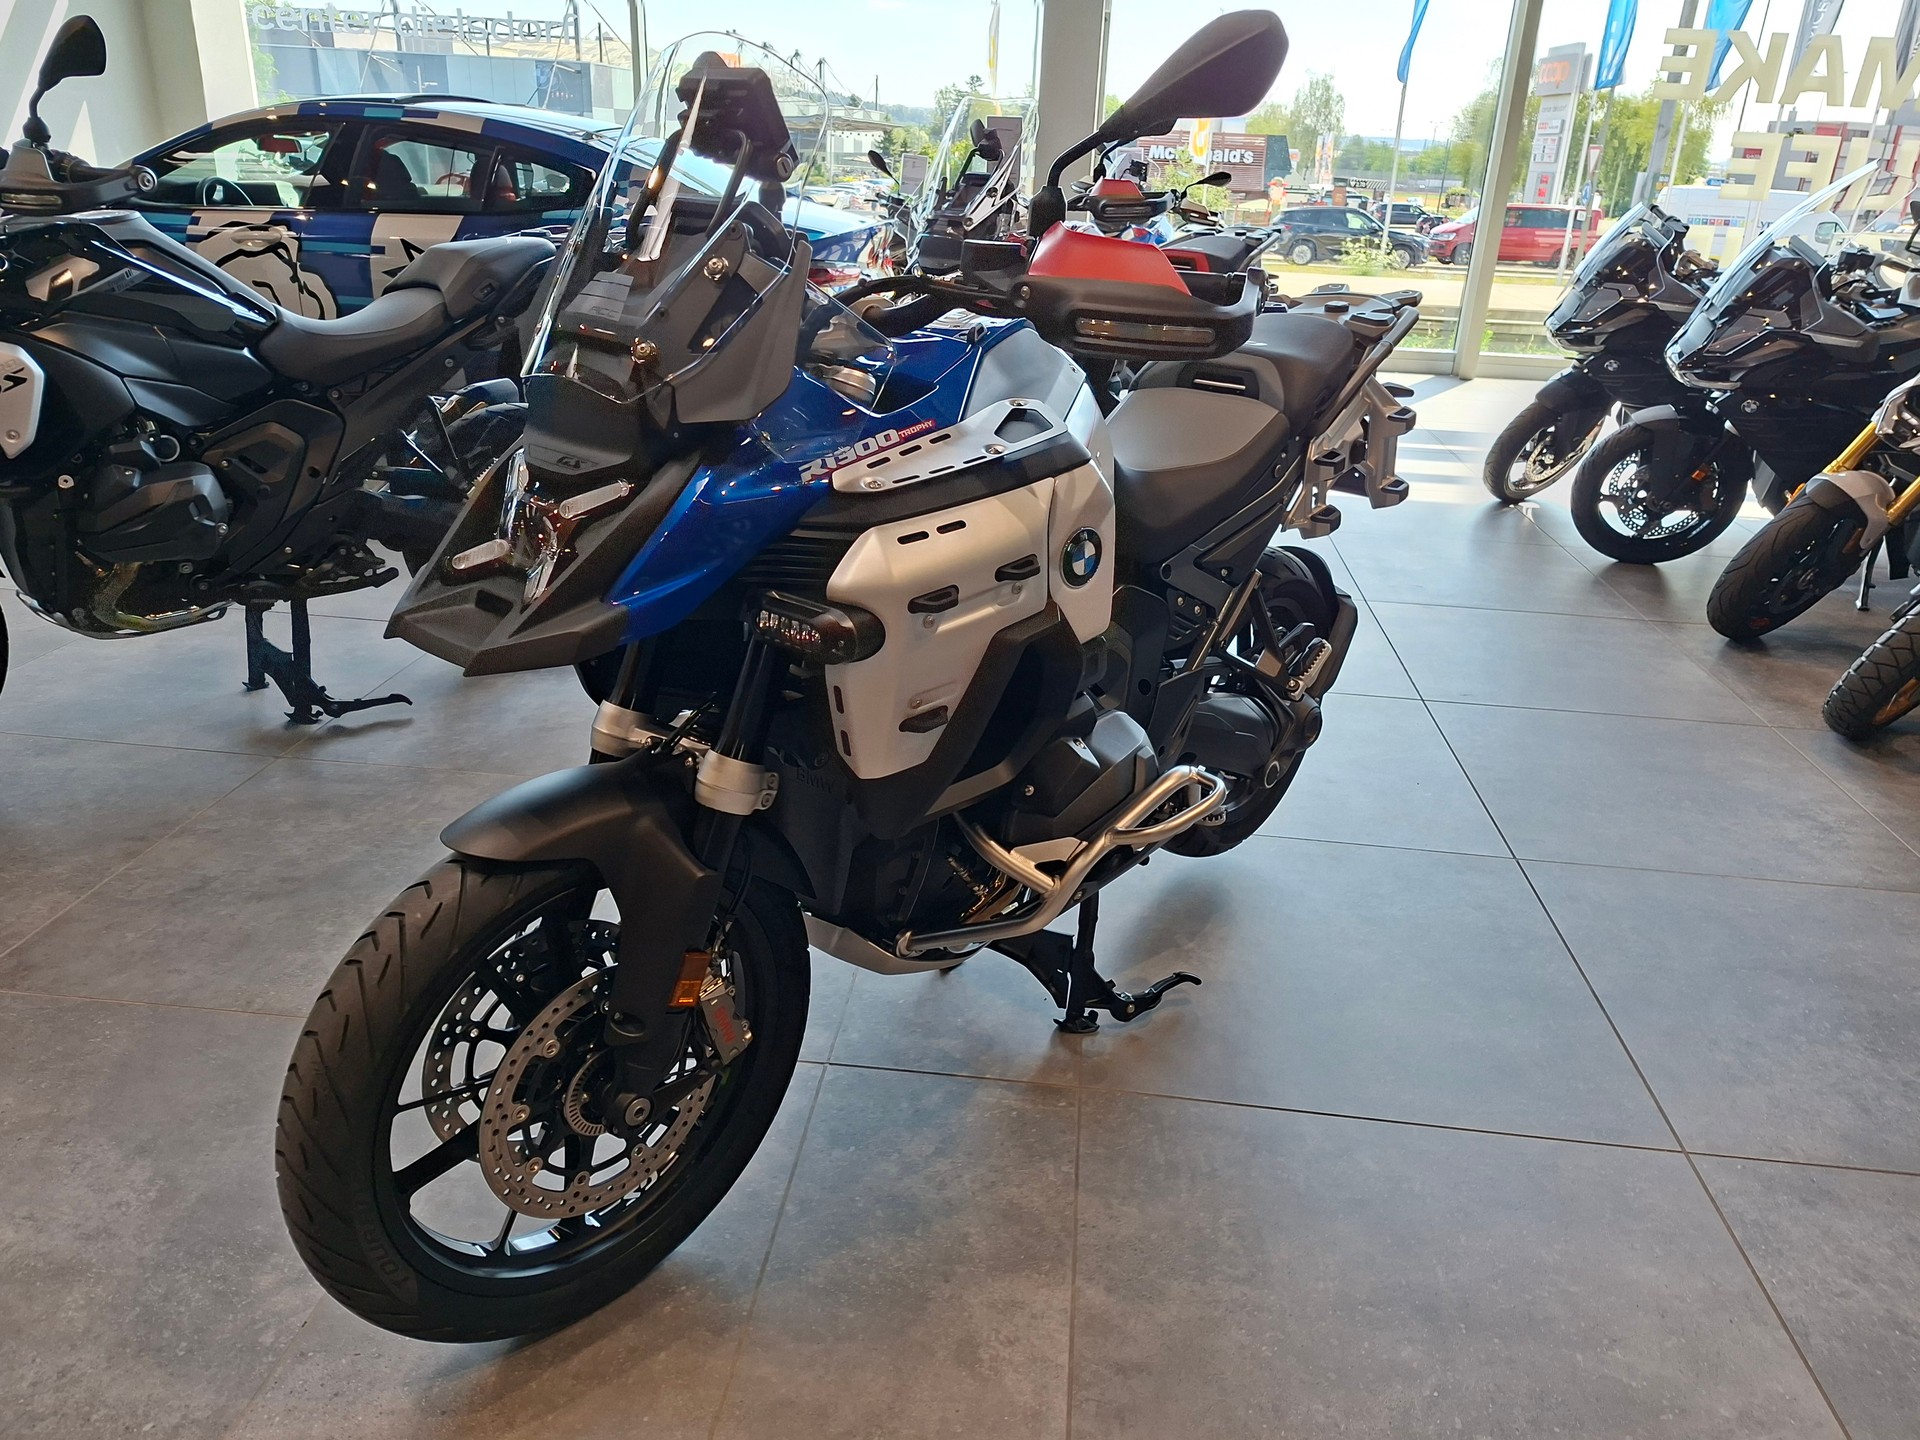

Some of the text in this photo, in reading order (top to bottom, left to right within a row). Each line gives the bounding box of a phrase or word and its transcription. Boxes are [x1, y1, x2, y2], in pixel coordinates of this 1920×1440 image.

[251, 3, 578, 45] center dielsdorf
[898, 420, 934, 438] TROPHY
